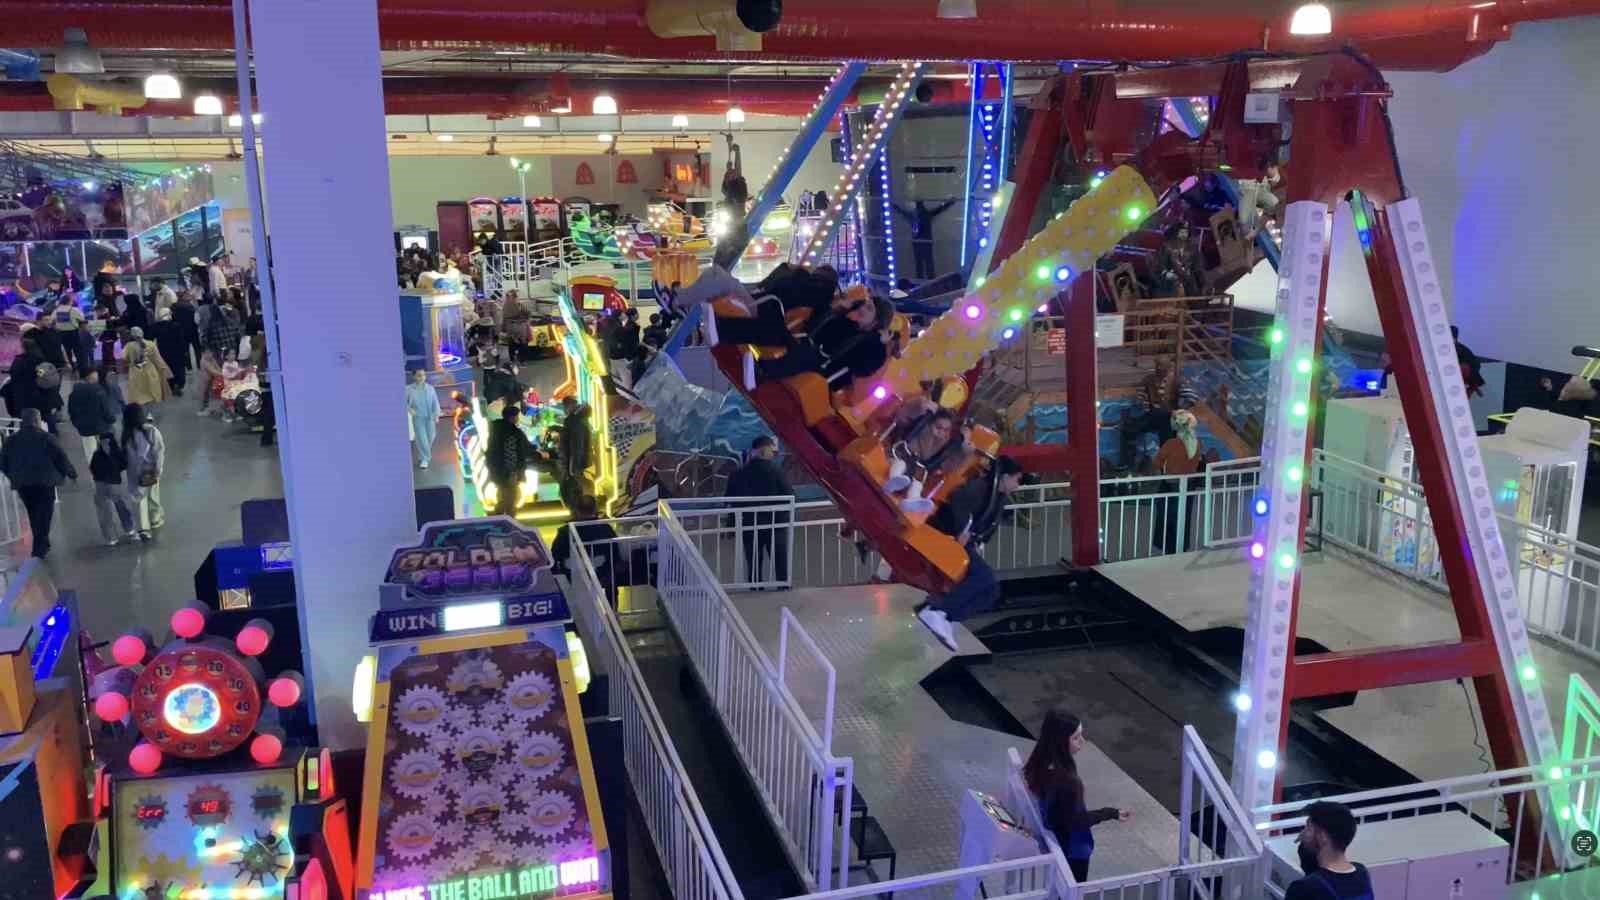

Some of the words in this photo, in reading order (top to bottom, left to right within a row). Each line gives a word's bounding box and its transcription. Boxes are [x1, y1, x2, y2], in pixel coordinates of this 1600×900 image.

[399, 545, 540, 571] GOLDEN
[389, 613, 437, 631] WIN
[508, 600, 553, 618] BIG!
[427, 879, 466, 900] THE
[467, 872, 516, 900] BALL
[519, 864, 558, 895] AND
